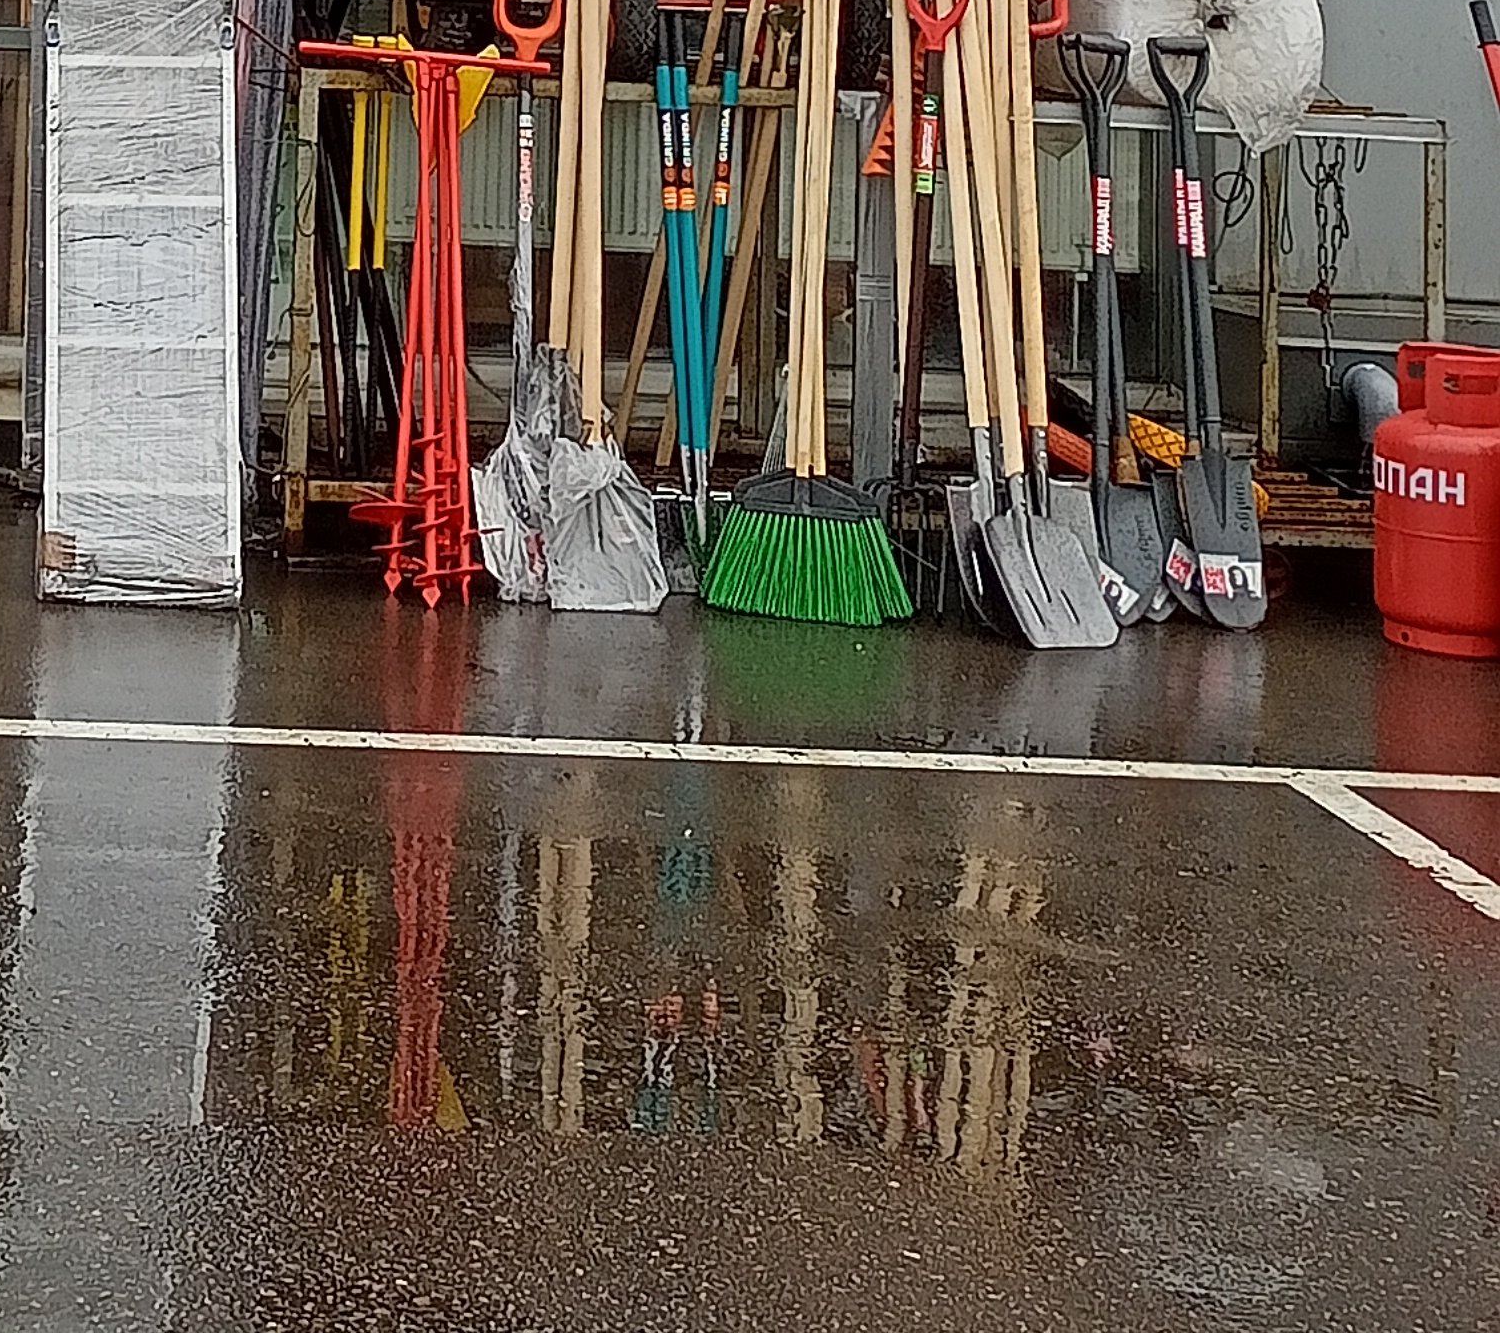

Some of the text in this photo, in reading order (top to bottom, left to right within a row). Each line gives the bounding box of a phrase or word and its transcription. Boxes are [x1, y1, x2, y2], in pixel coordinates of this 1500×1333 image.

[662, 111, 674, 168] GRINDA
[681, 111, 692, 168] GRINDA
[719, 107, 731, 162] GRINDA
